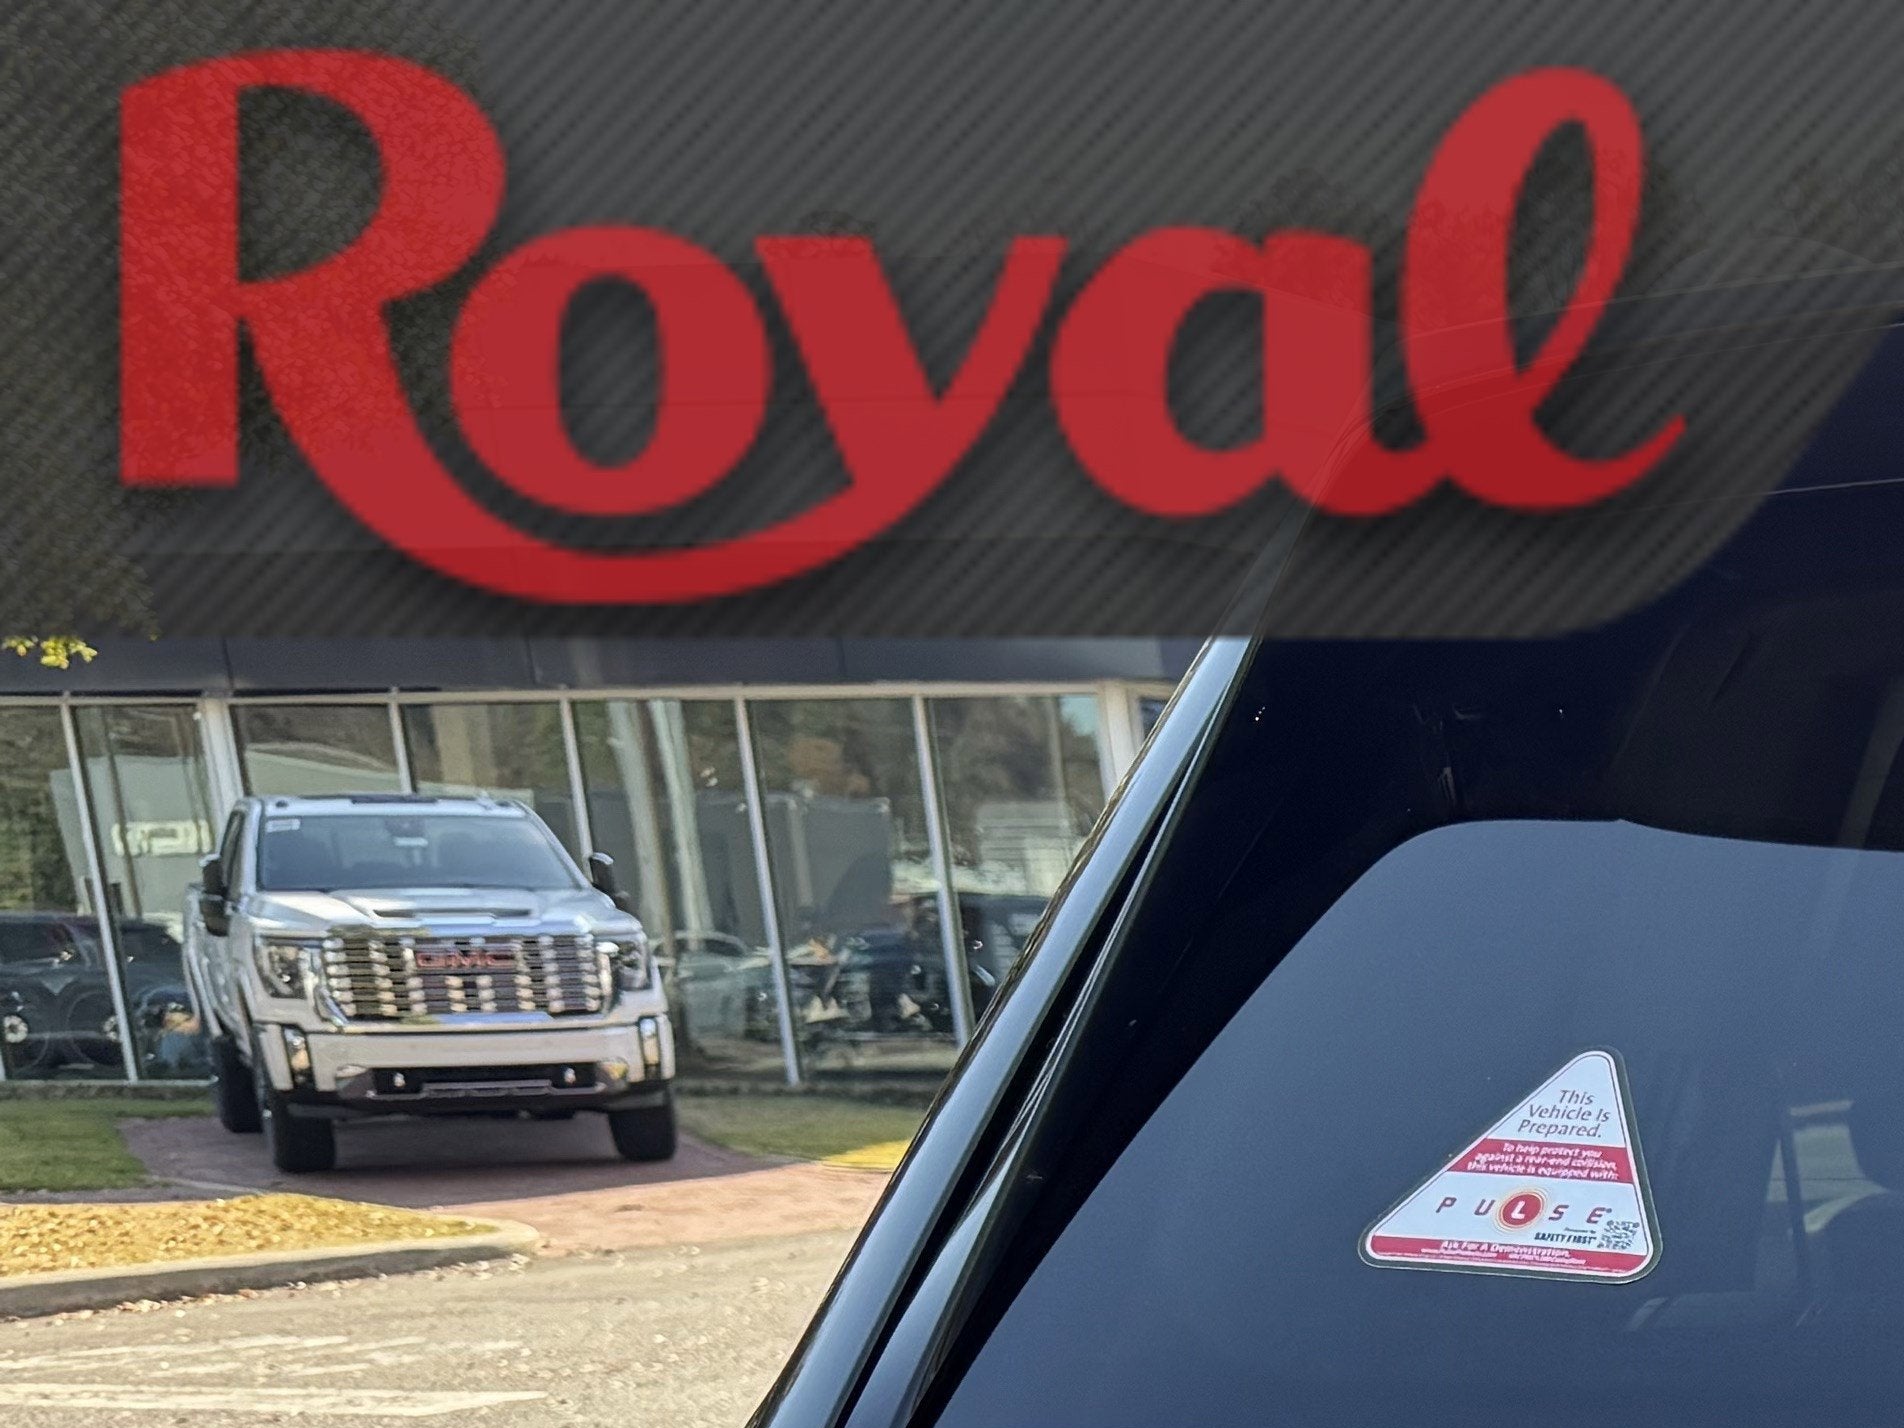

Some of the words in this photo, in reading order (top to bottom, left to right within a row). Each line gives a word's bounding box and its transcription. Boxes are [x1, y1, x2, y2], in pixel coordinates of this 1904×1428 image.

[1559, 1088, 1596, 1105] This
[1529, 1104, 1592, 1121] Vehicle
[1595, 1108, 1611, 1123] Is
[1517, 1118, 1602, 1138] Prepared.
[1540, 1146, 1580, 1158] protect
[1488, 1163, 1526, 1174] vehicle
